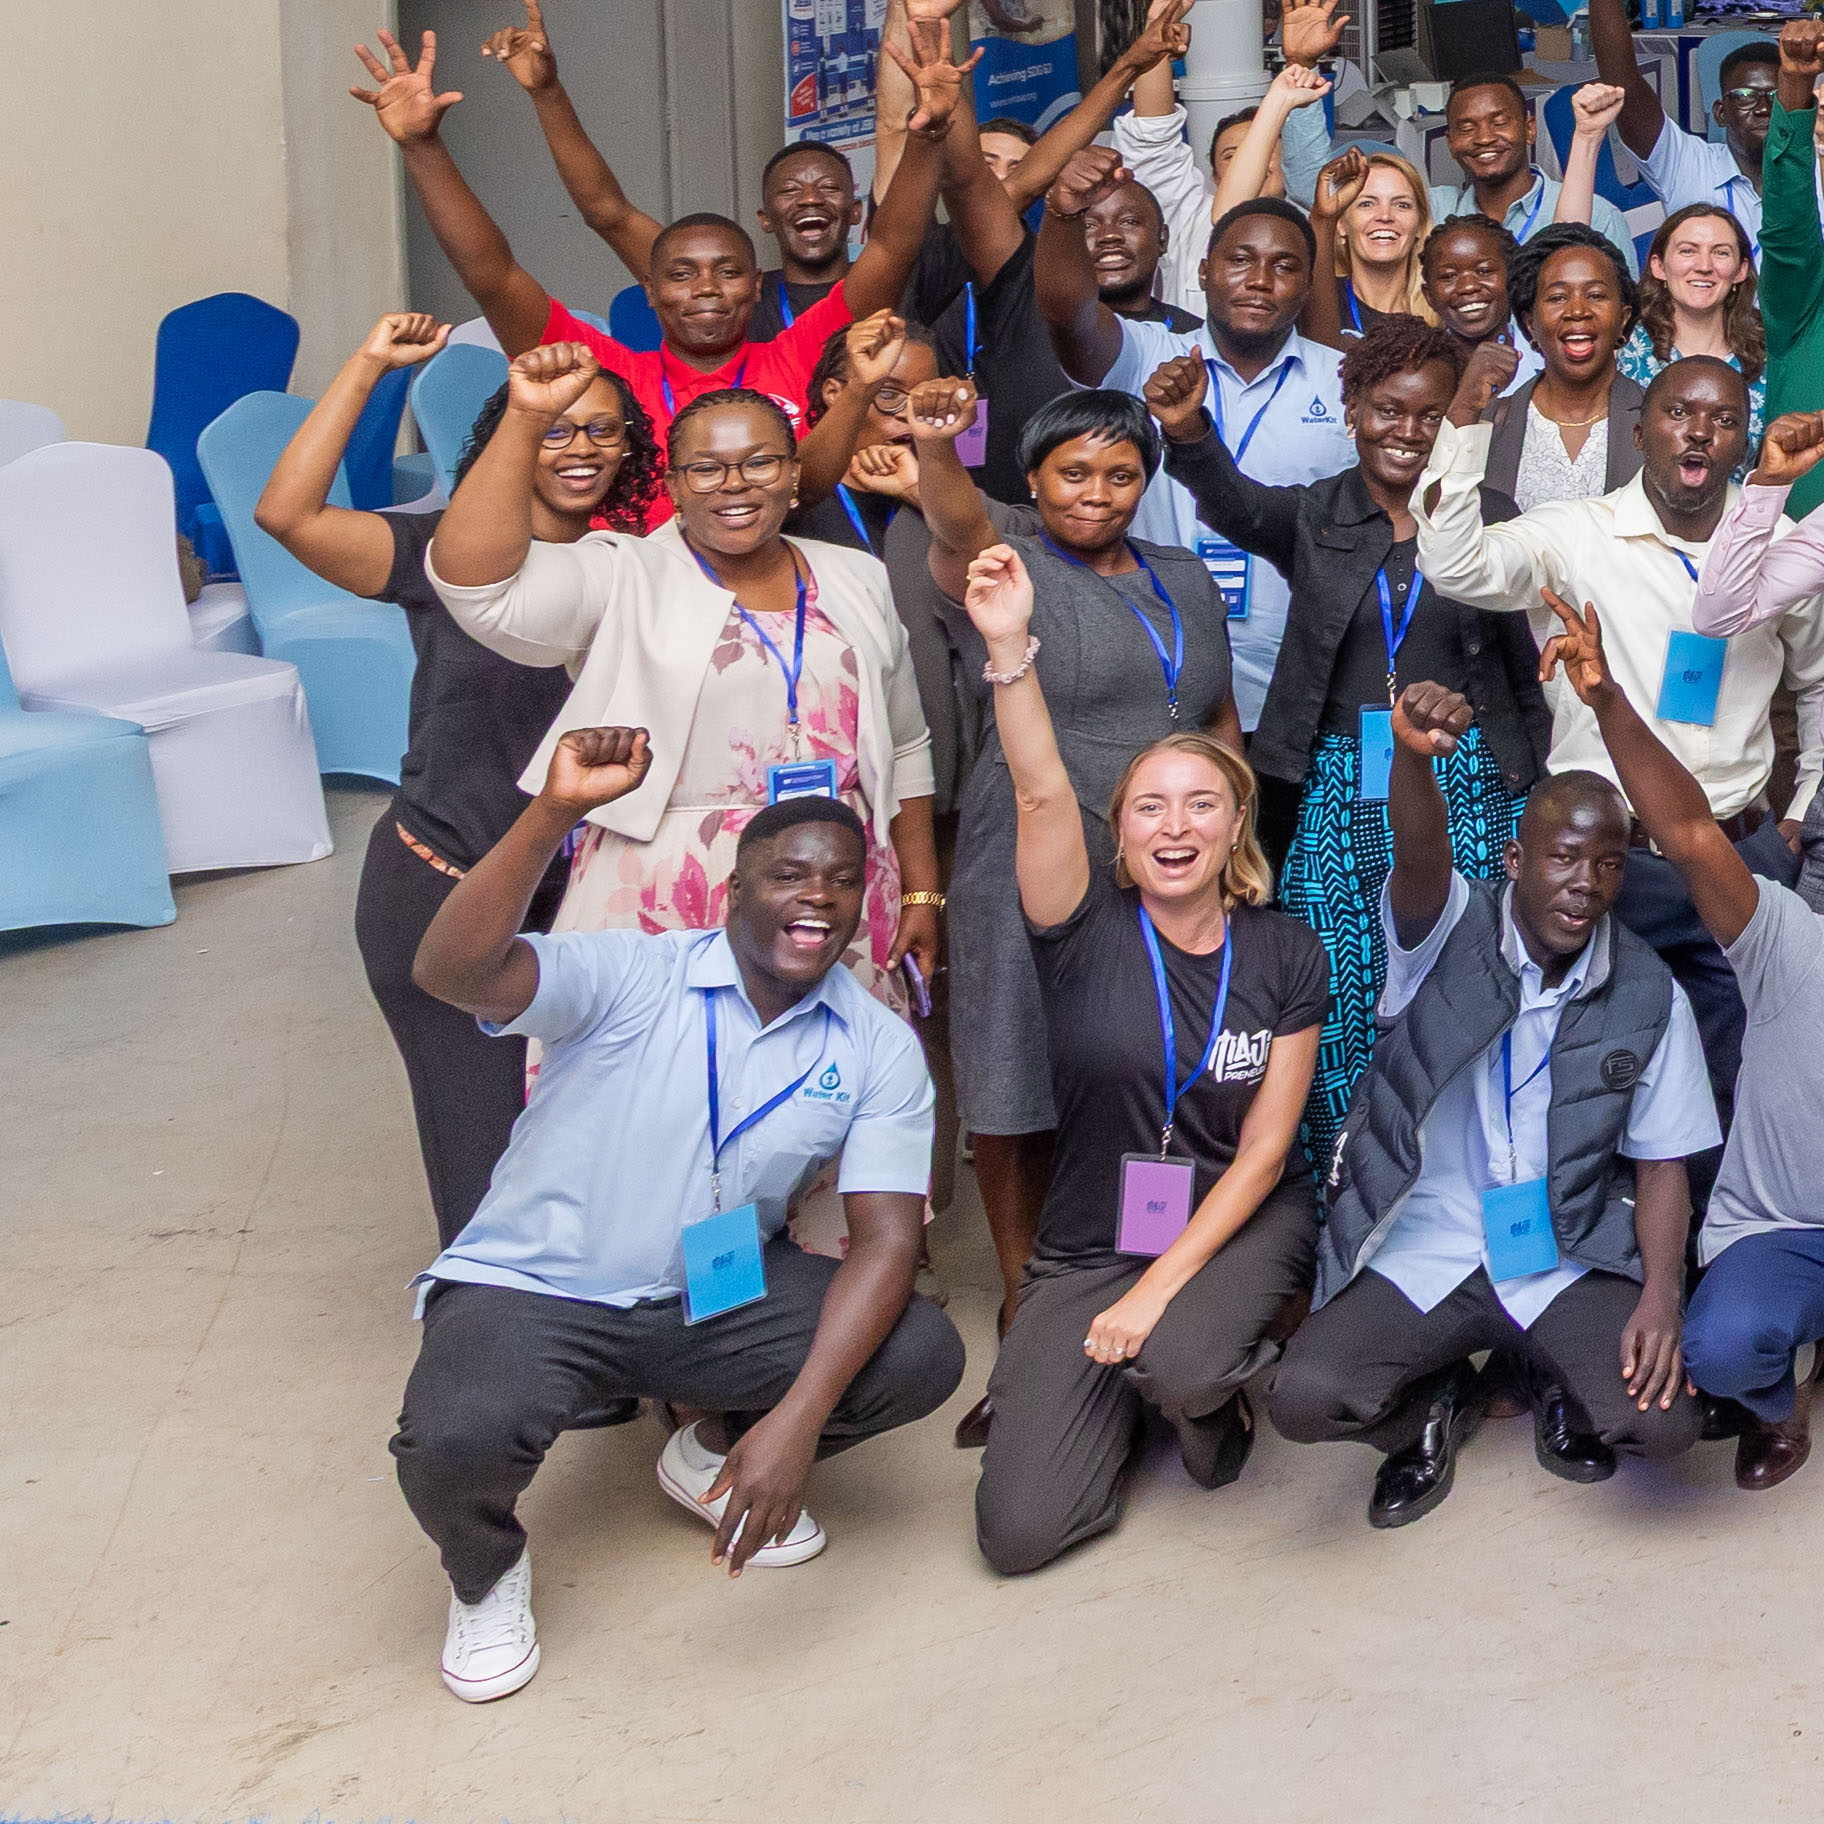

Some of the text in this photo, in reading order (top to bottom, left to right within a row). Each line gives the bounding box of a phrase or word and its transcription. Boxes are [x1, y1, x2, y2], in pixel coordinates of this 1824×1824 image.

[1300, 416, 1337, 425] WaterKit
[803, 1087, 851, 1103] Water Kit
